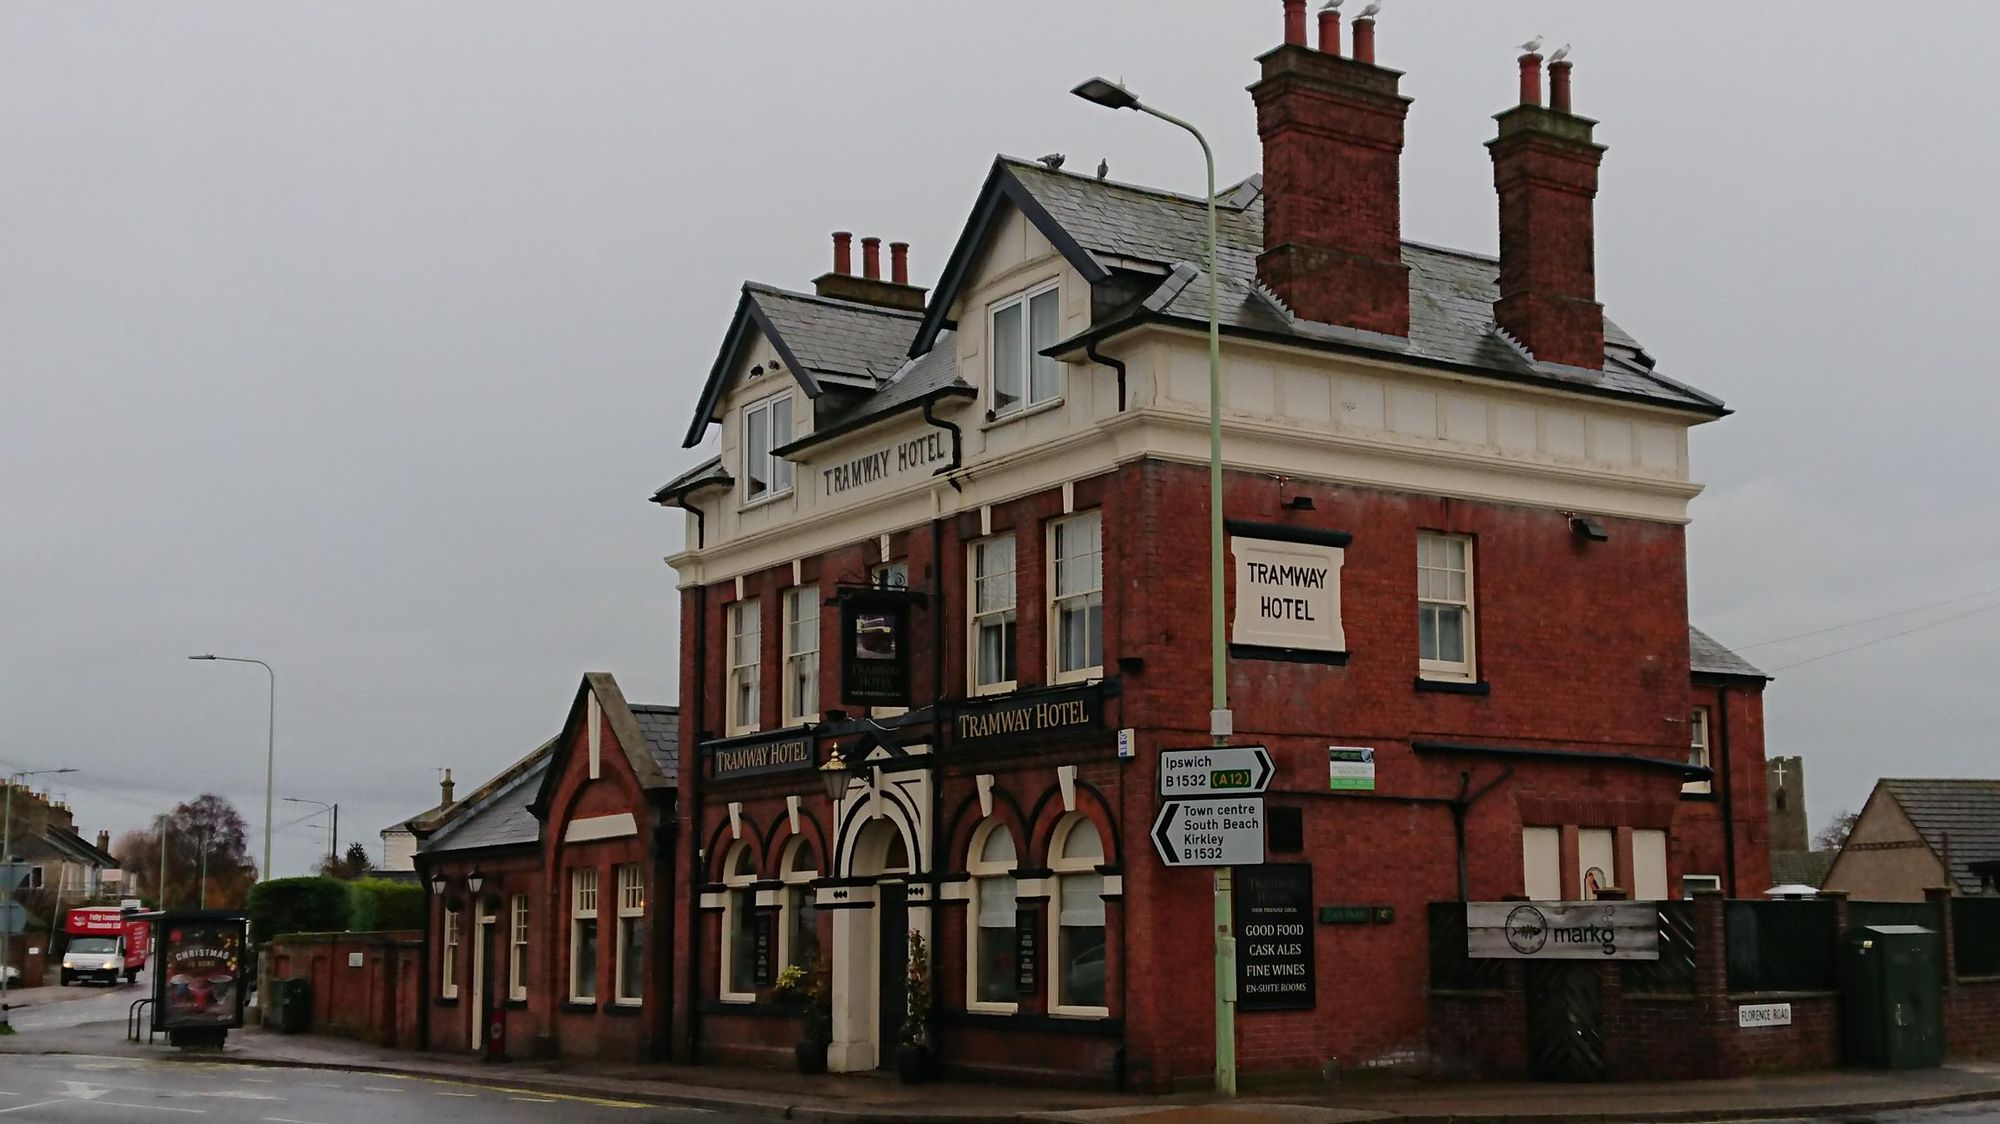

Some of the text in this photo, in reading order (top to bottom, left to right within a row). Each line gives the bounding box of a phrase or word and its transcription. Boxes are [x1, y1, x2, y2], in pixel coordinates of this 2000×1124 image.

[823, 431, 946, 496] TRAMWAY HOTEL
[1247, 562, 1328, 589] TRAMWAY
[1261, 596, 1315, 621] HOTEL
[959, 701, 1089, 739] TRAMWAY HOTEL
[716, 742, 807, 772] TRAMWAY HOTEL
[1166, 755, 1212, 771] Ipswich
[1184, 803, 1255, 817] Town centre
[1184, 817, 1259, 833] South Beach
[1184, 834, 1224, 847] Kirkley
[1245, 923, 1304, 937] GOOD FOOD
[1554, 924, 1616, 955] markg
[175, 947, 230, 961] CHRISTMAS
[1249, 943, 1302, 956] CASK ALES
[1246, 963, 1306, 977] FINE WINES
[1246, 982, 1307, 994] EN-SUITE ROOMS
[1741, 1008, 1790, 1022] FLORENCE ROAD
